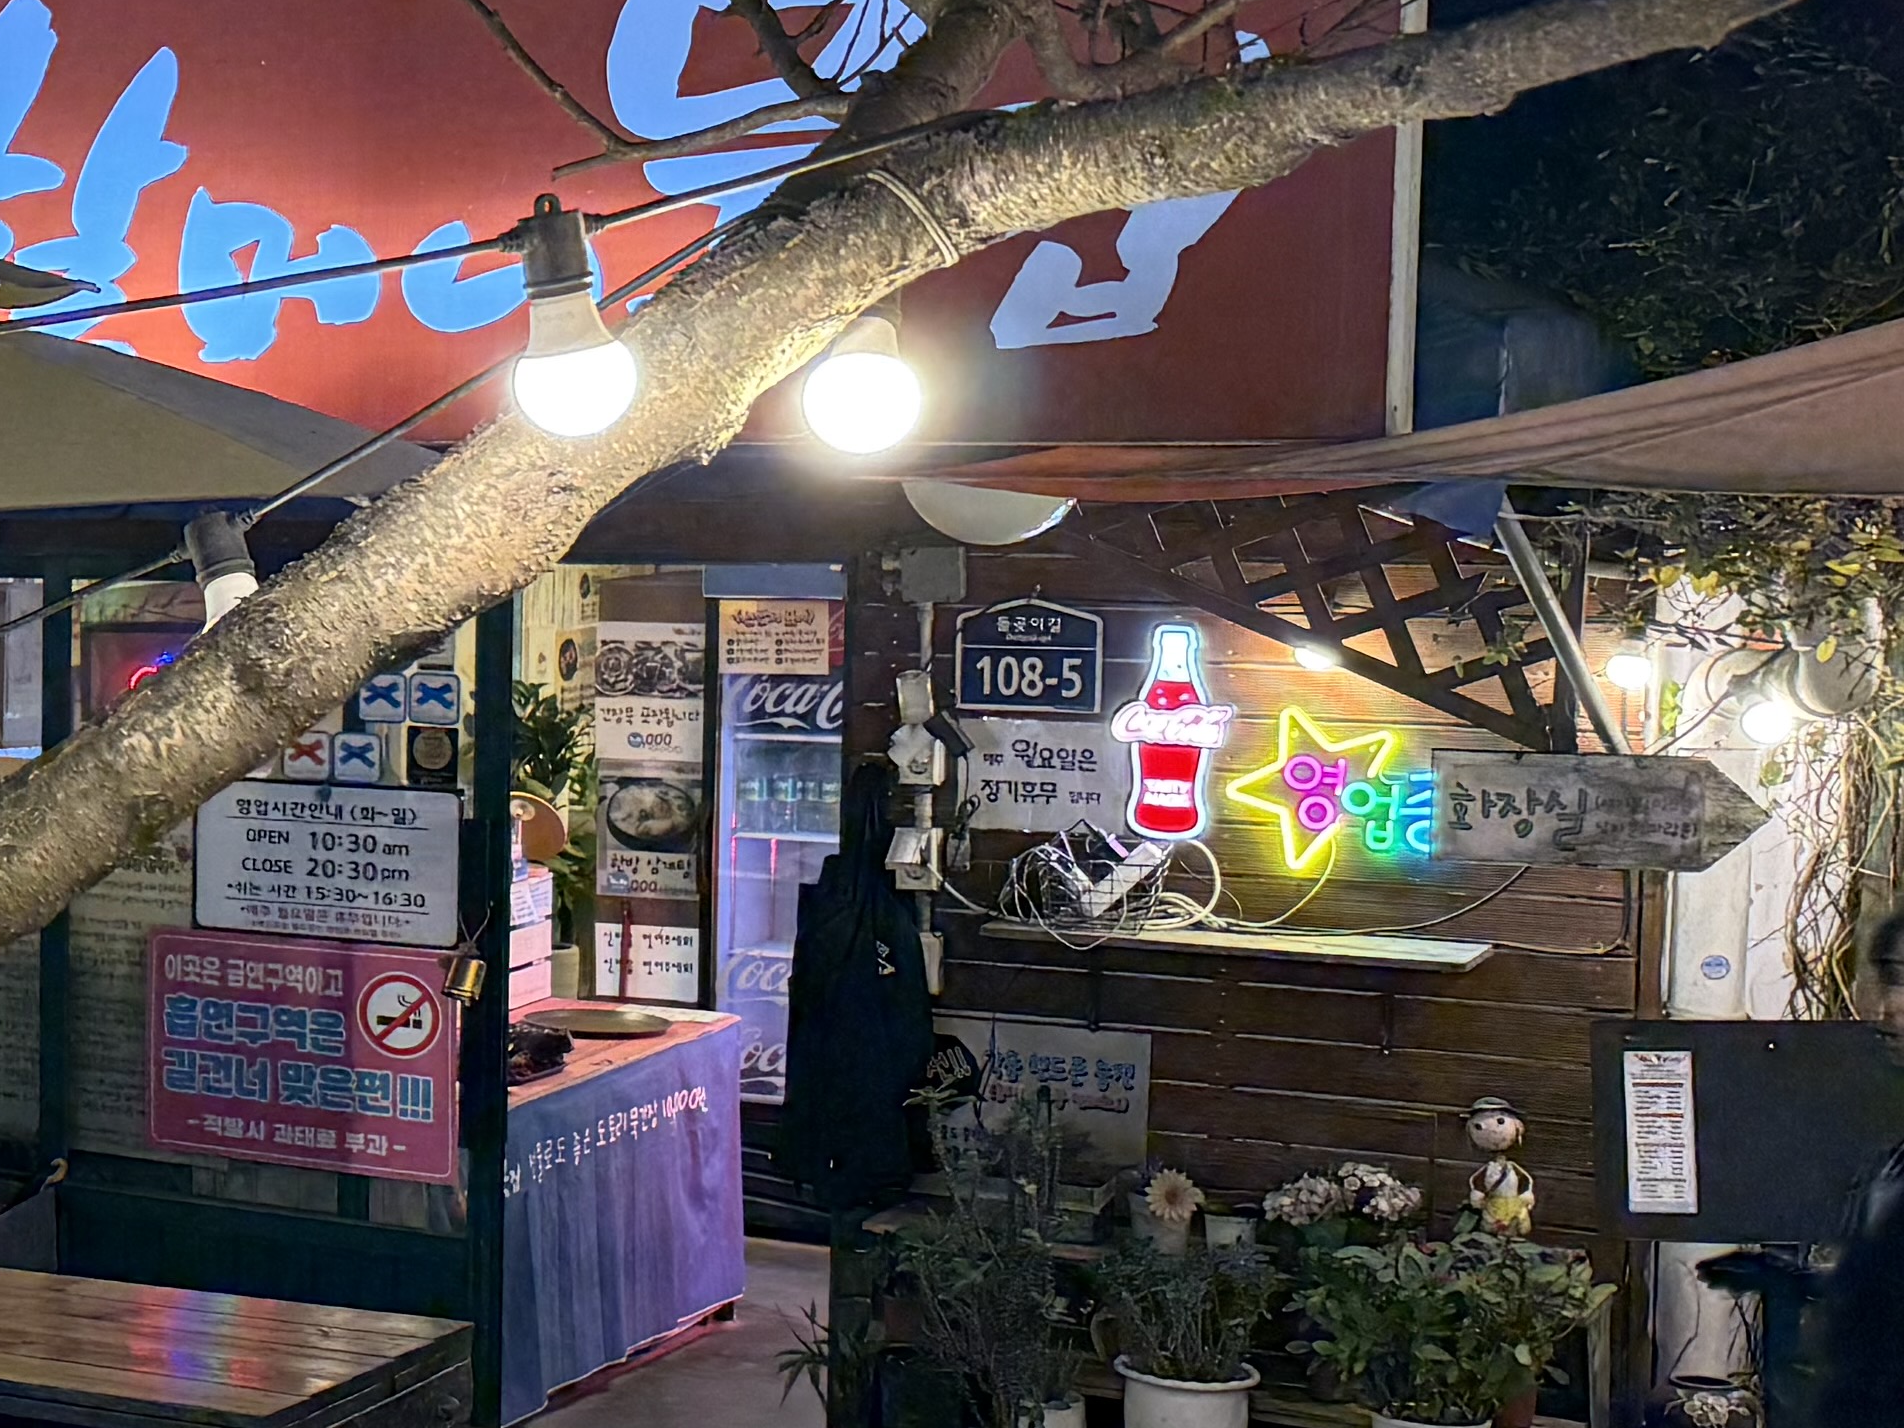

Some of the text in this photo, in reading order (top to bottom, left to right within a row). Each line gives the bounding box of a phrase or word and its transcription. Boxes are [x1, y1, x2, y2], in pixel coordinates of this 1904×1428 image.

[976, 656, 1083, 699] 108-5
[1011, 739, 1097, 772] 월요일은
[981, 779, 1057, 804] 정기휴무
[236, 798, 417, 825] 영업시간안내 (화~일)
[1447, 781, 1588, 852] 화장실
[247, 829, 409, 856] OPEN 10:30 am
[242, 857, 409, 882] CLOSE 20:30 pm
[268, 884, 297, 900] 시간
[165, 954, 344, 997] 이곳은 금연구역이고
[163, 992, 345, 1057] 흡연구역은
[162, 1046, 270, 1103] 길건너
[273, 1124, 337, 1150] 과태료
